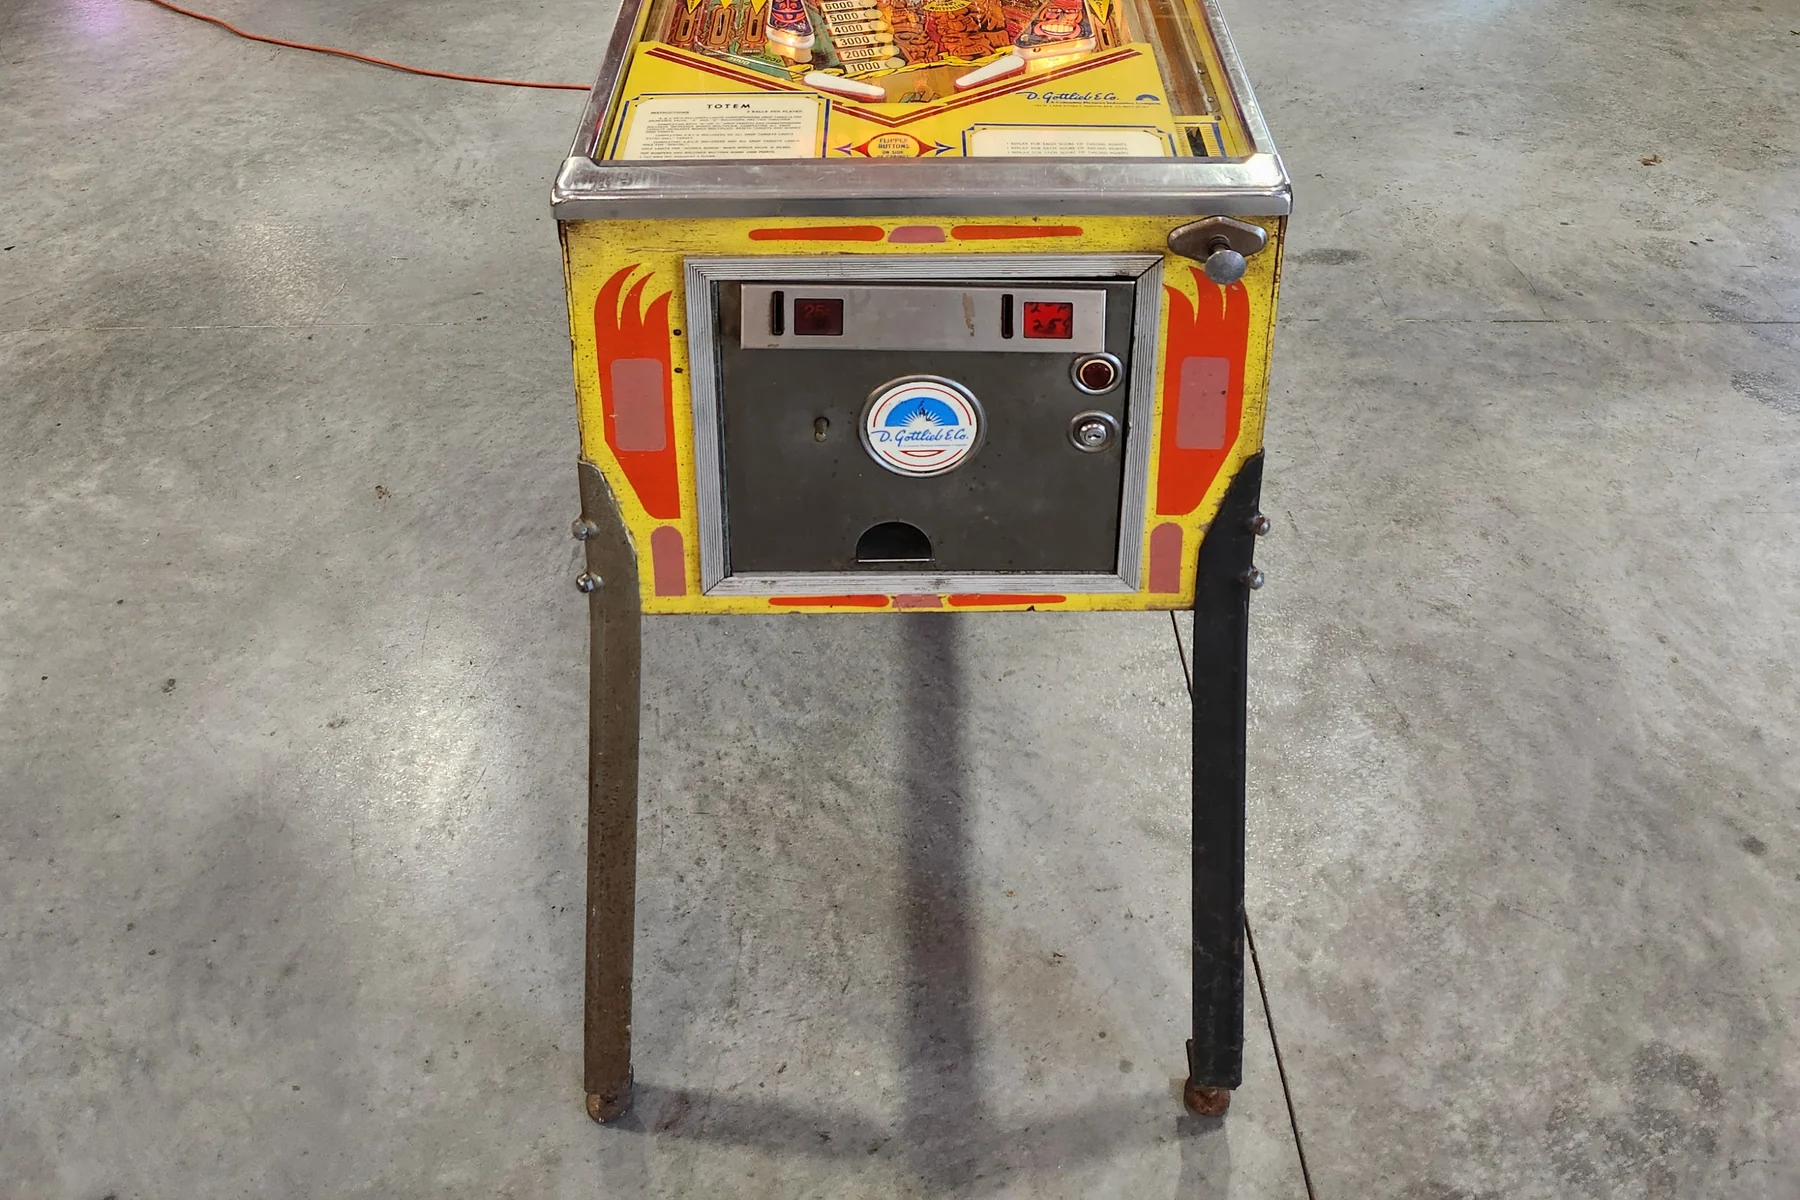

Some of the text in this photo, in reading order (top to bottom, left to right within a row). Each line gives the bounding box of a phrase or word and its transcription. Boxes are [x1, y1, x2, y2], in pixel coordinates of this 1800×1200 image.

[824, 1, 854, 10] 6000
[829, 12, 859, 22] 5000
[834, 24, 863, 34] 4000
[840, 36, 870, 46] 3000
[845, 49, 875, 59] 2000
[851, 61, 881, 71] 1000
[1043, 90, 1092, 104] Gottlieb
[1104, 92, 1119, 101] Co.
[871, 430, 892, 442] D.
[895, 429, 943, 447] Gottlieb
[954, 428, 969, 440] Co.
